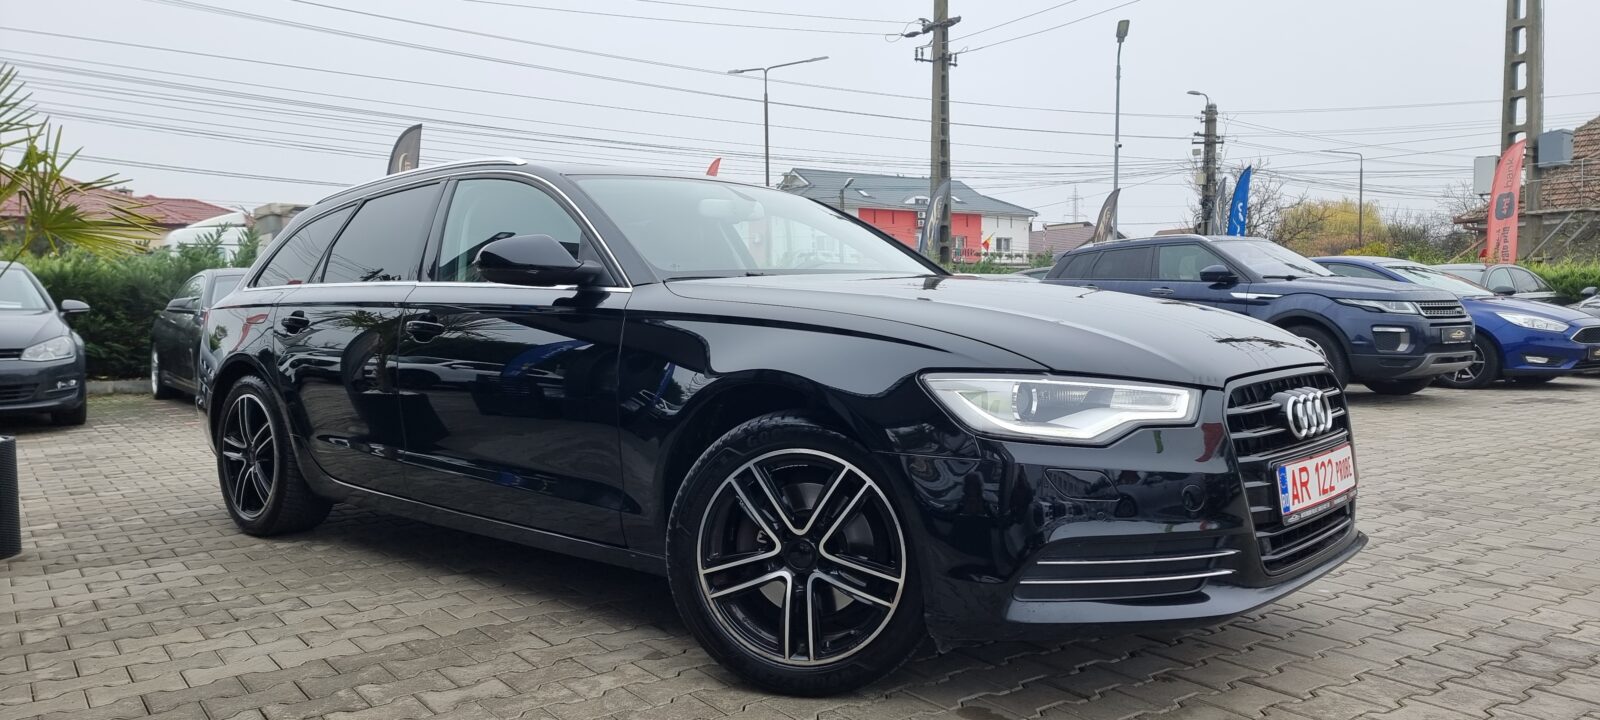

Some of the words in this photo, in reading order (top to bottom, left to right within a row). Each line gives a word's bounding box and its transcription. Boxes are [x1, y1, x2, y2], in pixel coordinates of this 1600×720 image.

[1504, 158, 1514, 188] bank
[1291, 466, 1311, 506] AR
[1315, 458, 1335, 496] 122
